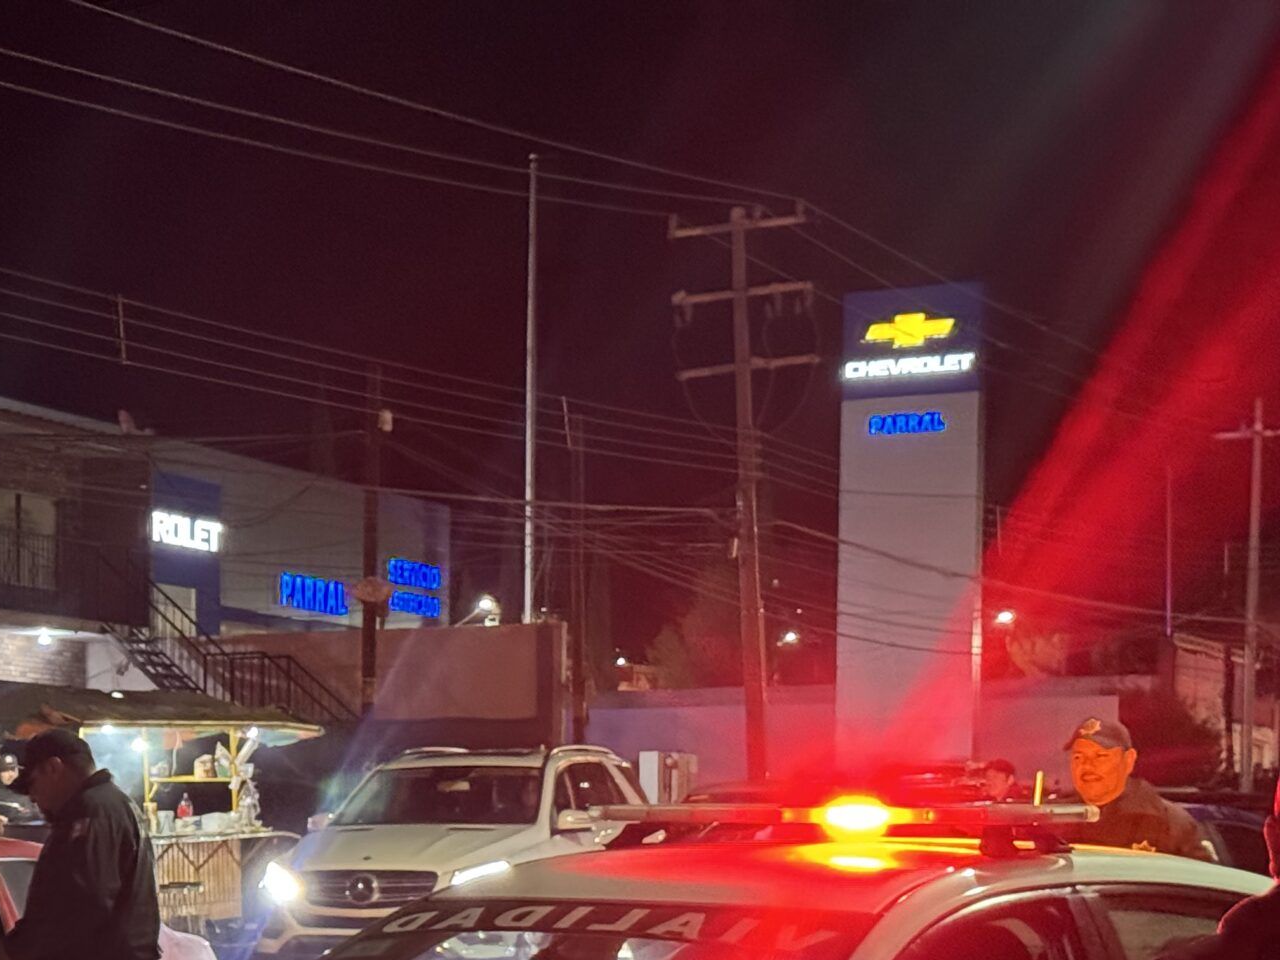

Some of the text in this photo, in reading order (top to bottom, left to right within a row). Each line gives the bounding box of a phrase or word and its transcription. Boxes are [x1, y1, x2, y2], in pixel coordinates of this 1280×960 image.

[845, 352, 975, 379] CHEVROLET
[869, 411, 946, 435] PARRAL
[280, 571, 348, 616] PARRAL
